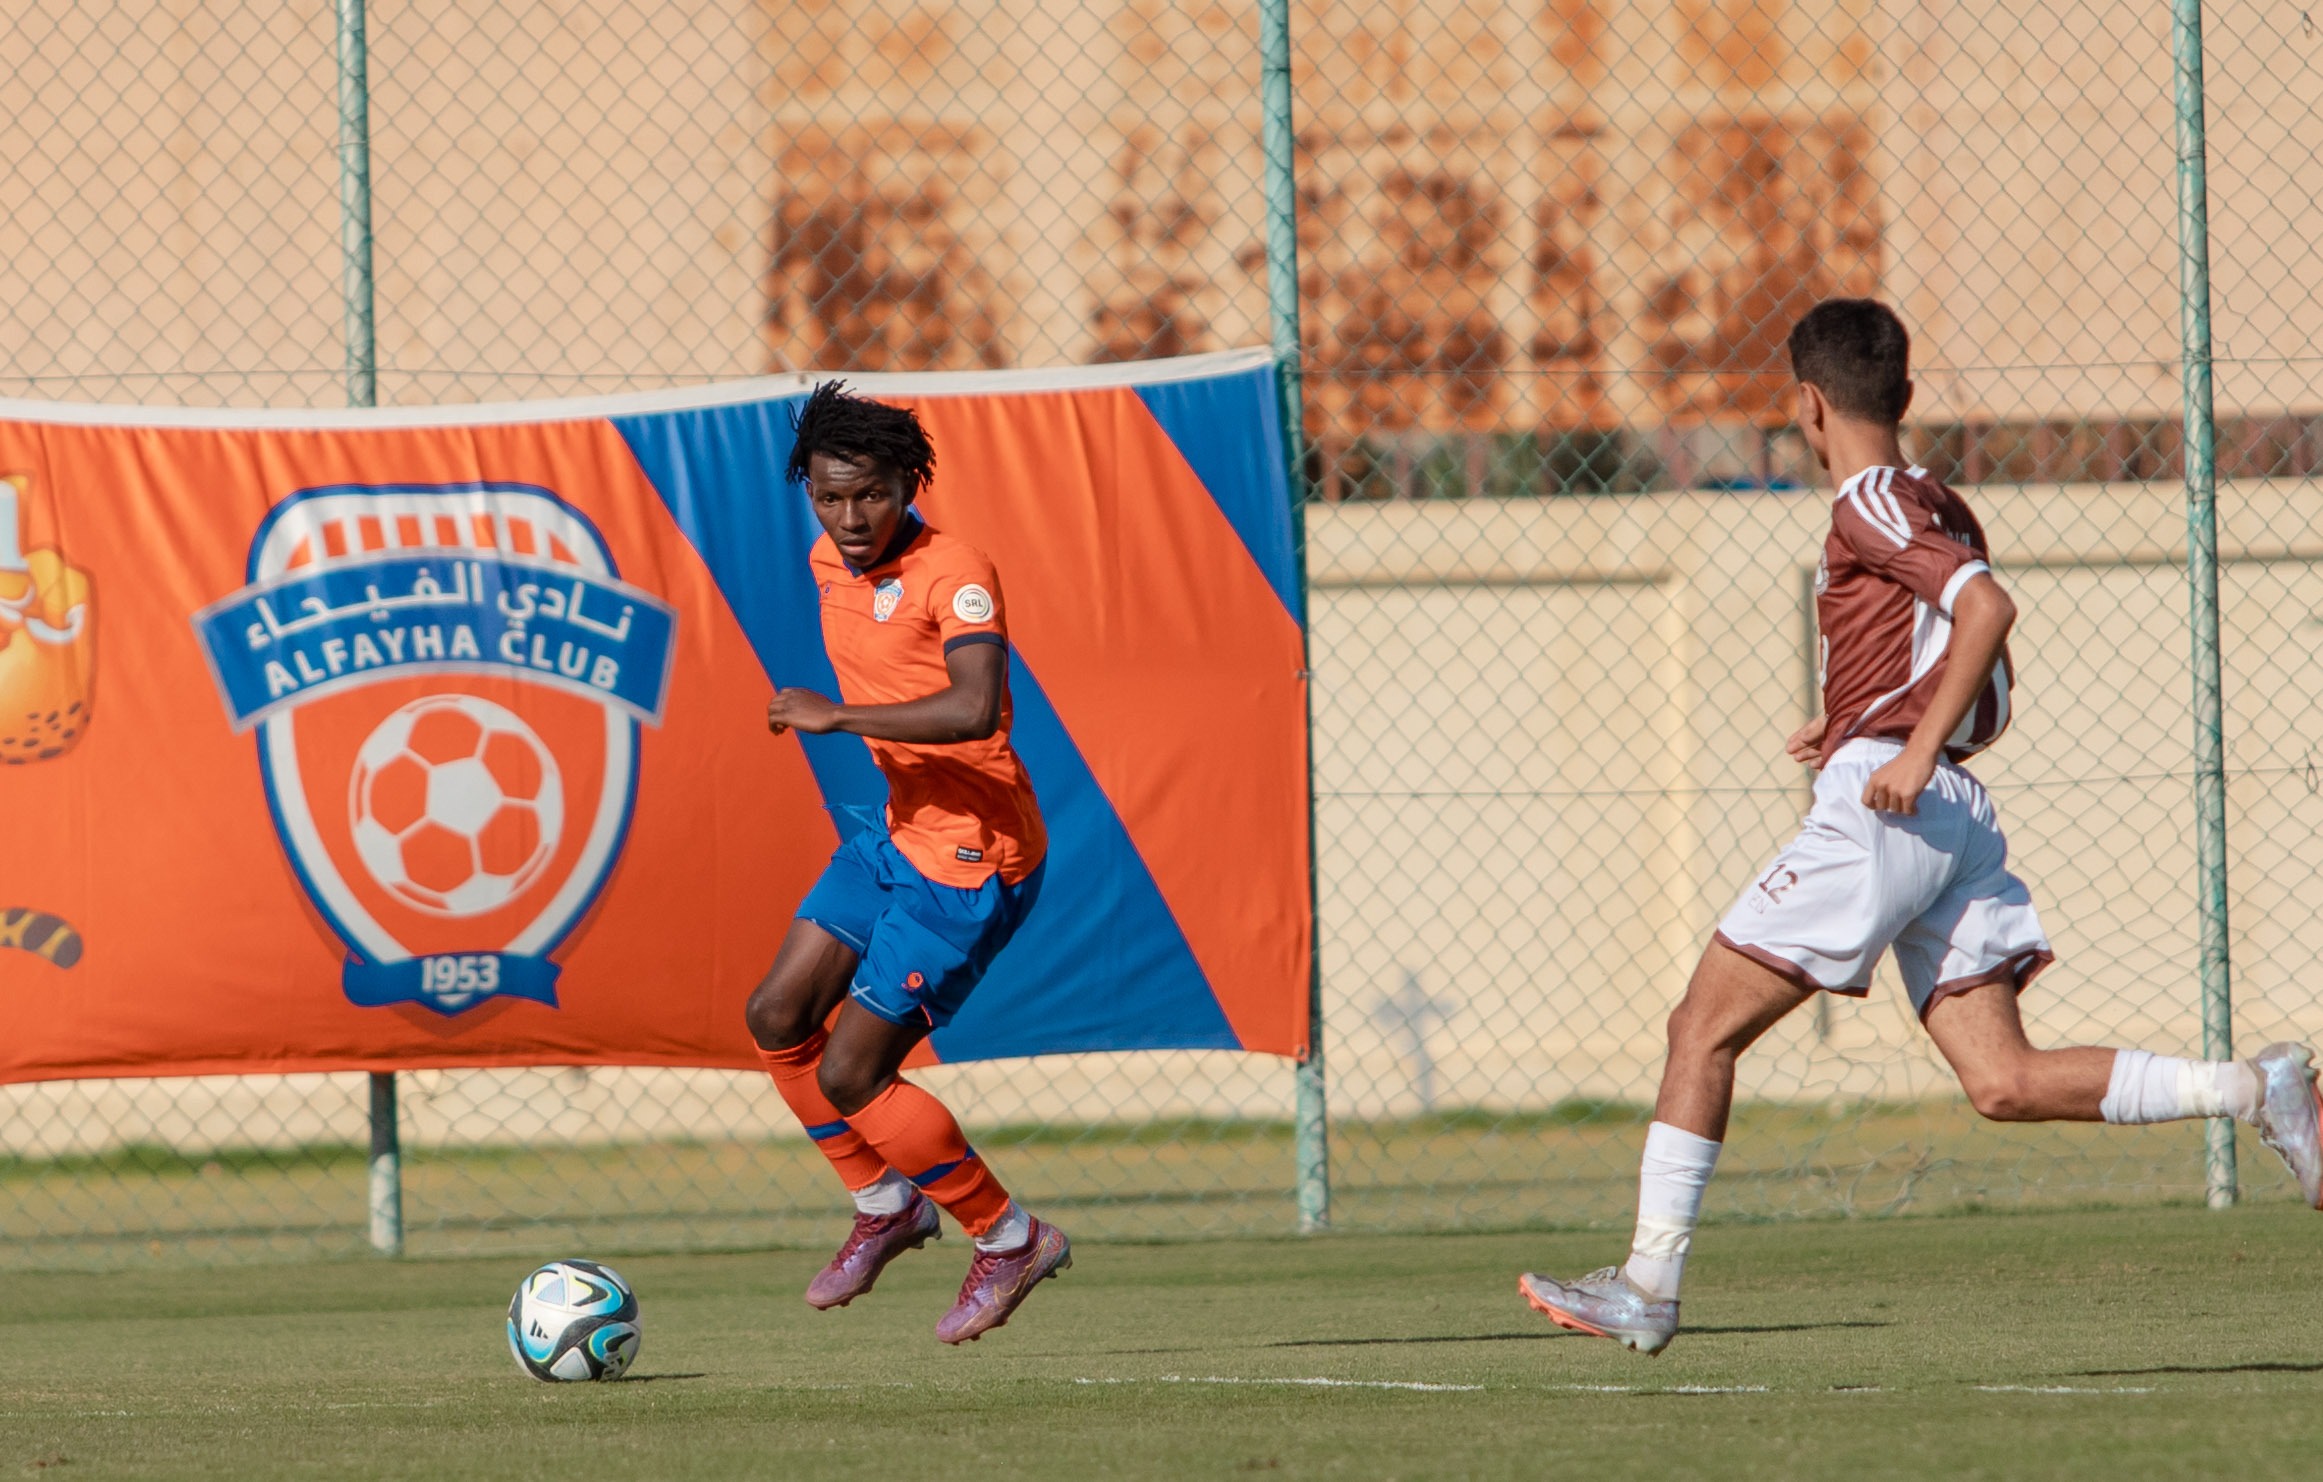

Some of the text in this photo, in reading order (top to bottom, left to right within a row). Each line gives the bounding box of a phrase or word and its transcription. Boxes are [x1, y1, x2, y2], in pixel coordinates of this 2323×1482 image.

[246, 561, 634, 650] نادي الفيحاء
[964, 598, 984, 608] SRL
[263, 623, 621, 698] ALFAYHA CLUB
[1758, 863, 1798, 905] 12
[421, 954, 500, 993] 1953
